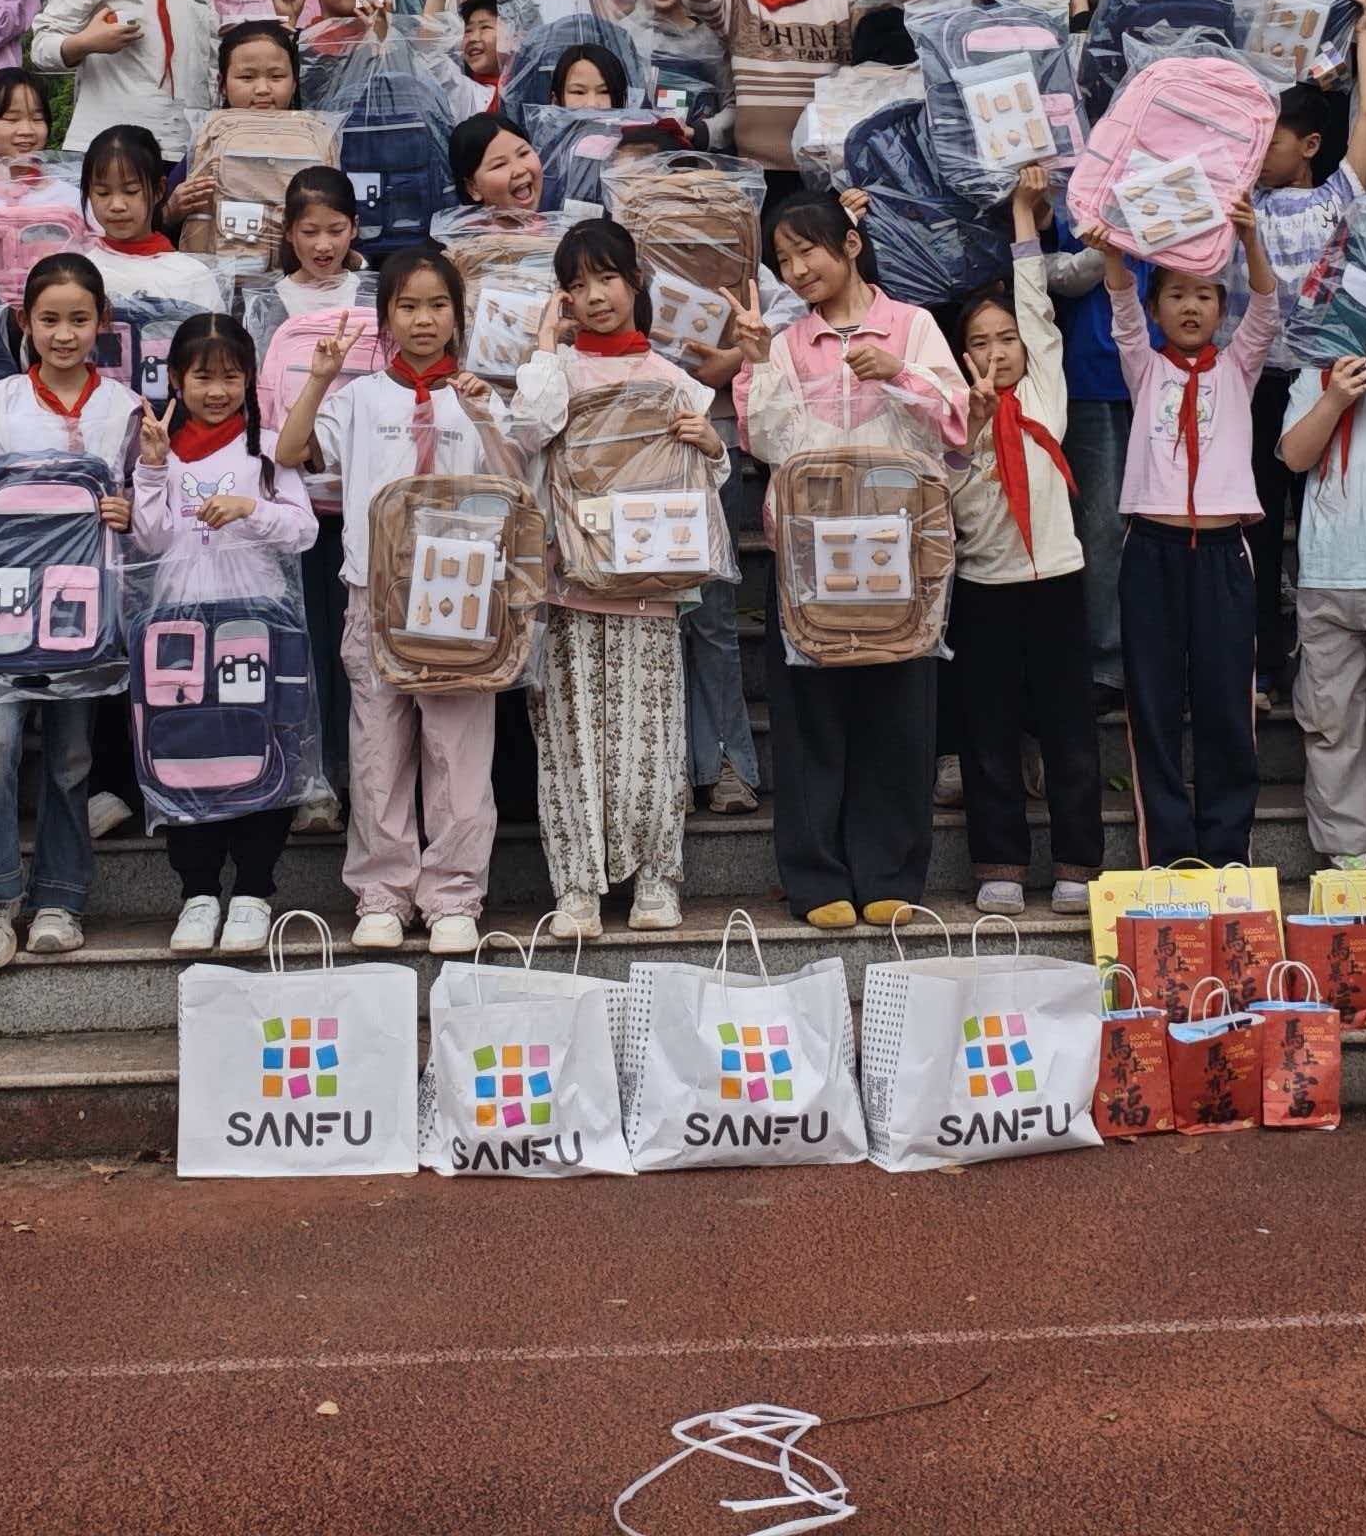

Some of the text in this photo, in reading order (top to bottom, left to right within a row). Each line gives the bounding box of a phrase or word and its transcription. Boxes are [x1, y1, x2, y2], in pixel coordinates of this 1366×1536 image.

[1146, 901, 1211, 915] DINOSAUR
[226, 1111, 372, 1147] SANFU
[684, 1111, 829, 1147] SANFU
[938, 1104, 1072, 1147] SANFU
[452, 1130, 584, 1171] SANFU
